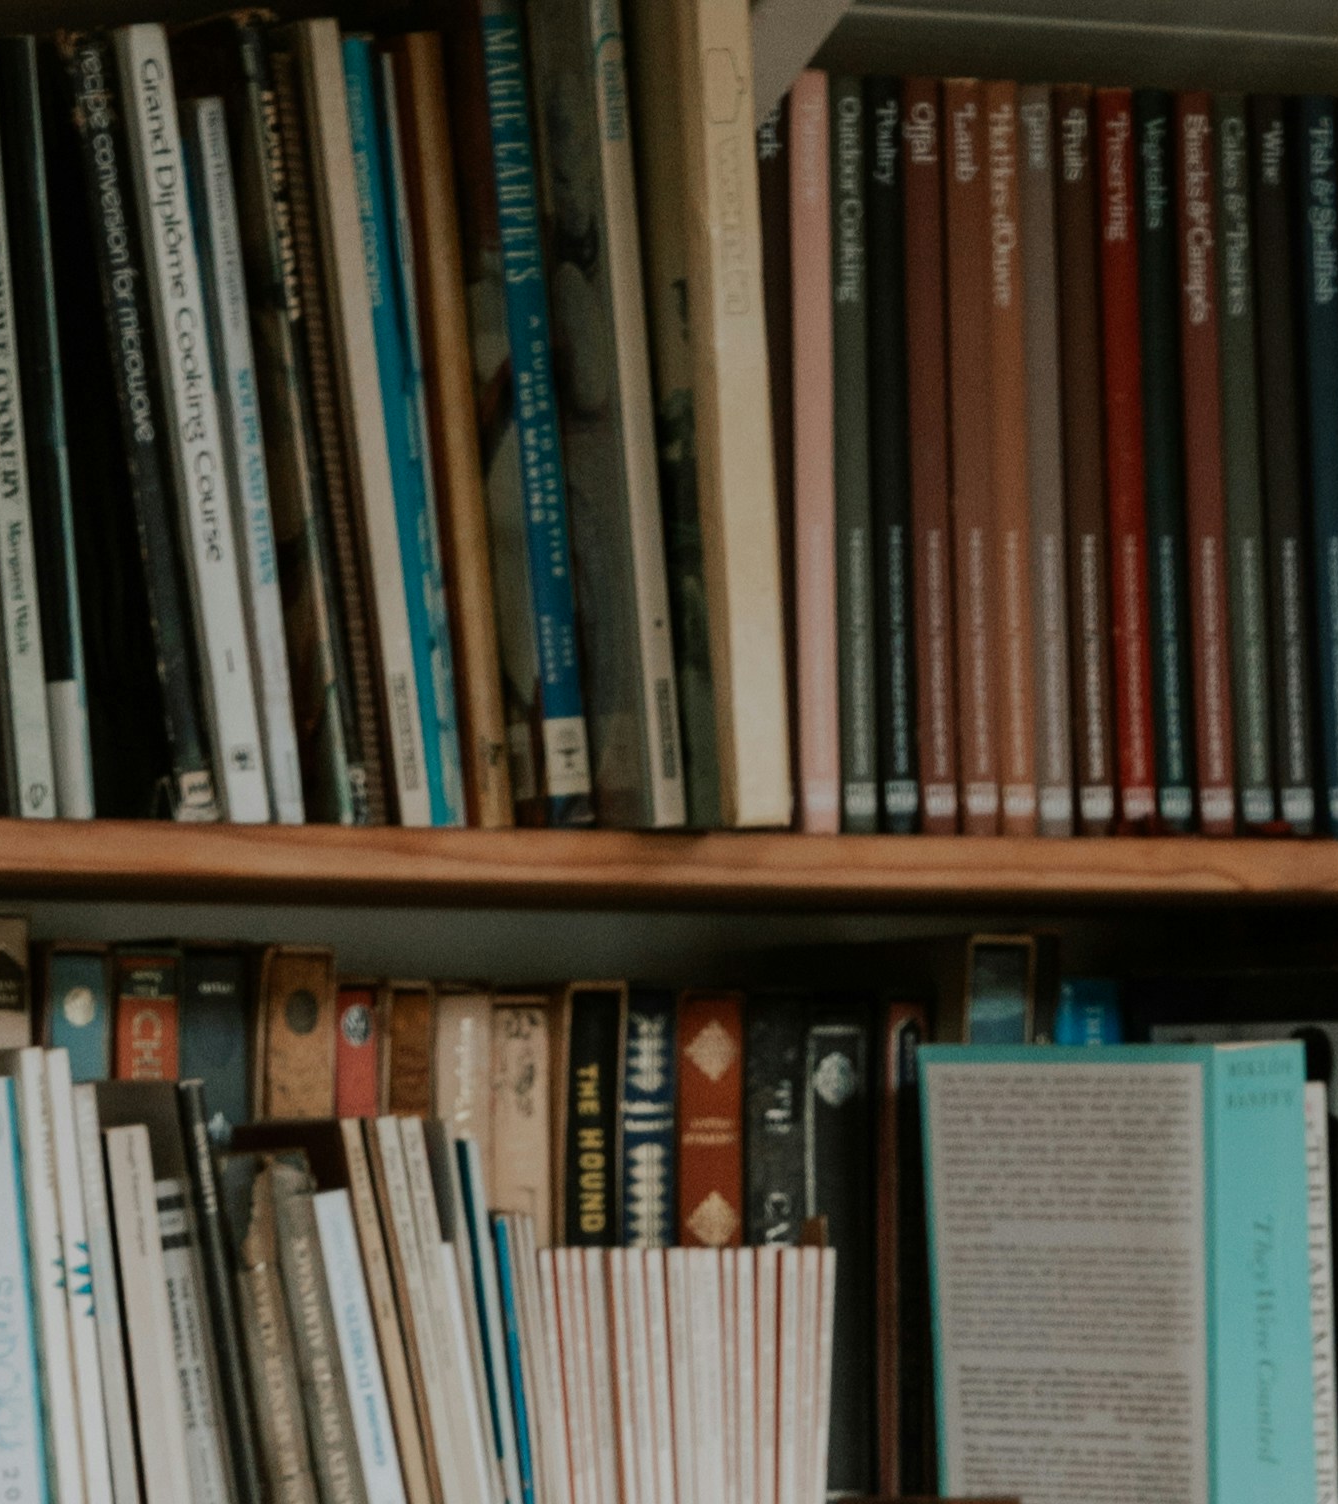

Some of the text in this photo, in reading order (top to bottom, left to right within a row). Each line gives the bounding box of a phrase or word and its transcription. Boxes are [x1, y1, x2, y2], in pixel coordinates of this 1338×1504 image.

[484, 27, 541, 284] MAGIC CARPETS
[836, 96, 864, 303] Outdoor Cooking
[872, 99, 899, 186] Poultry
[902, 102, 938, 164] Offal
[953, 102, 980, 184] Lamb
[1062, 107, 1089, 182] Fruits
[1103, 110, 1132, 243] Preserving
[1221, 116, 1247, 190] Cakes
[1262, 118, 1284, 185] Wine
[1307, 115, 1338, 305] Fish Shellfish
[90, 132, 157, 444] conversion microwave
[138, 56, 225, 562] Grand Diplôme Cooking Course
[576, 1063, 605, 1233] THE HOUND
